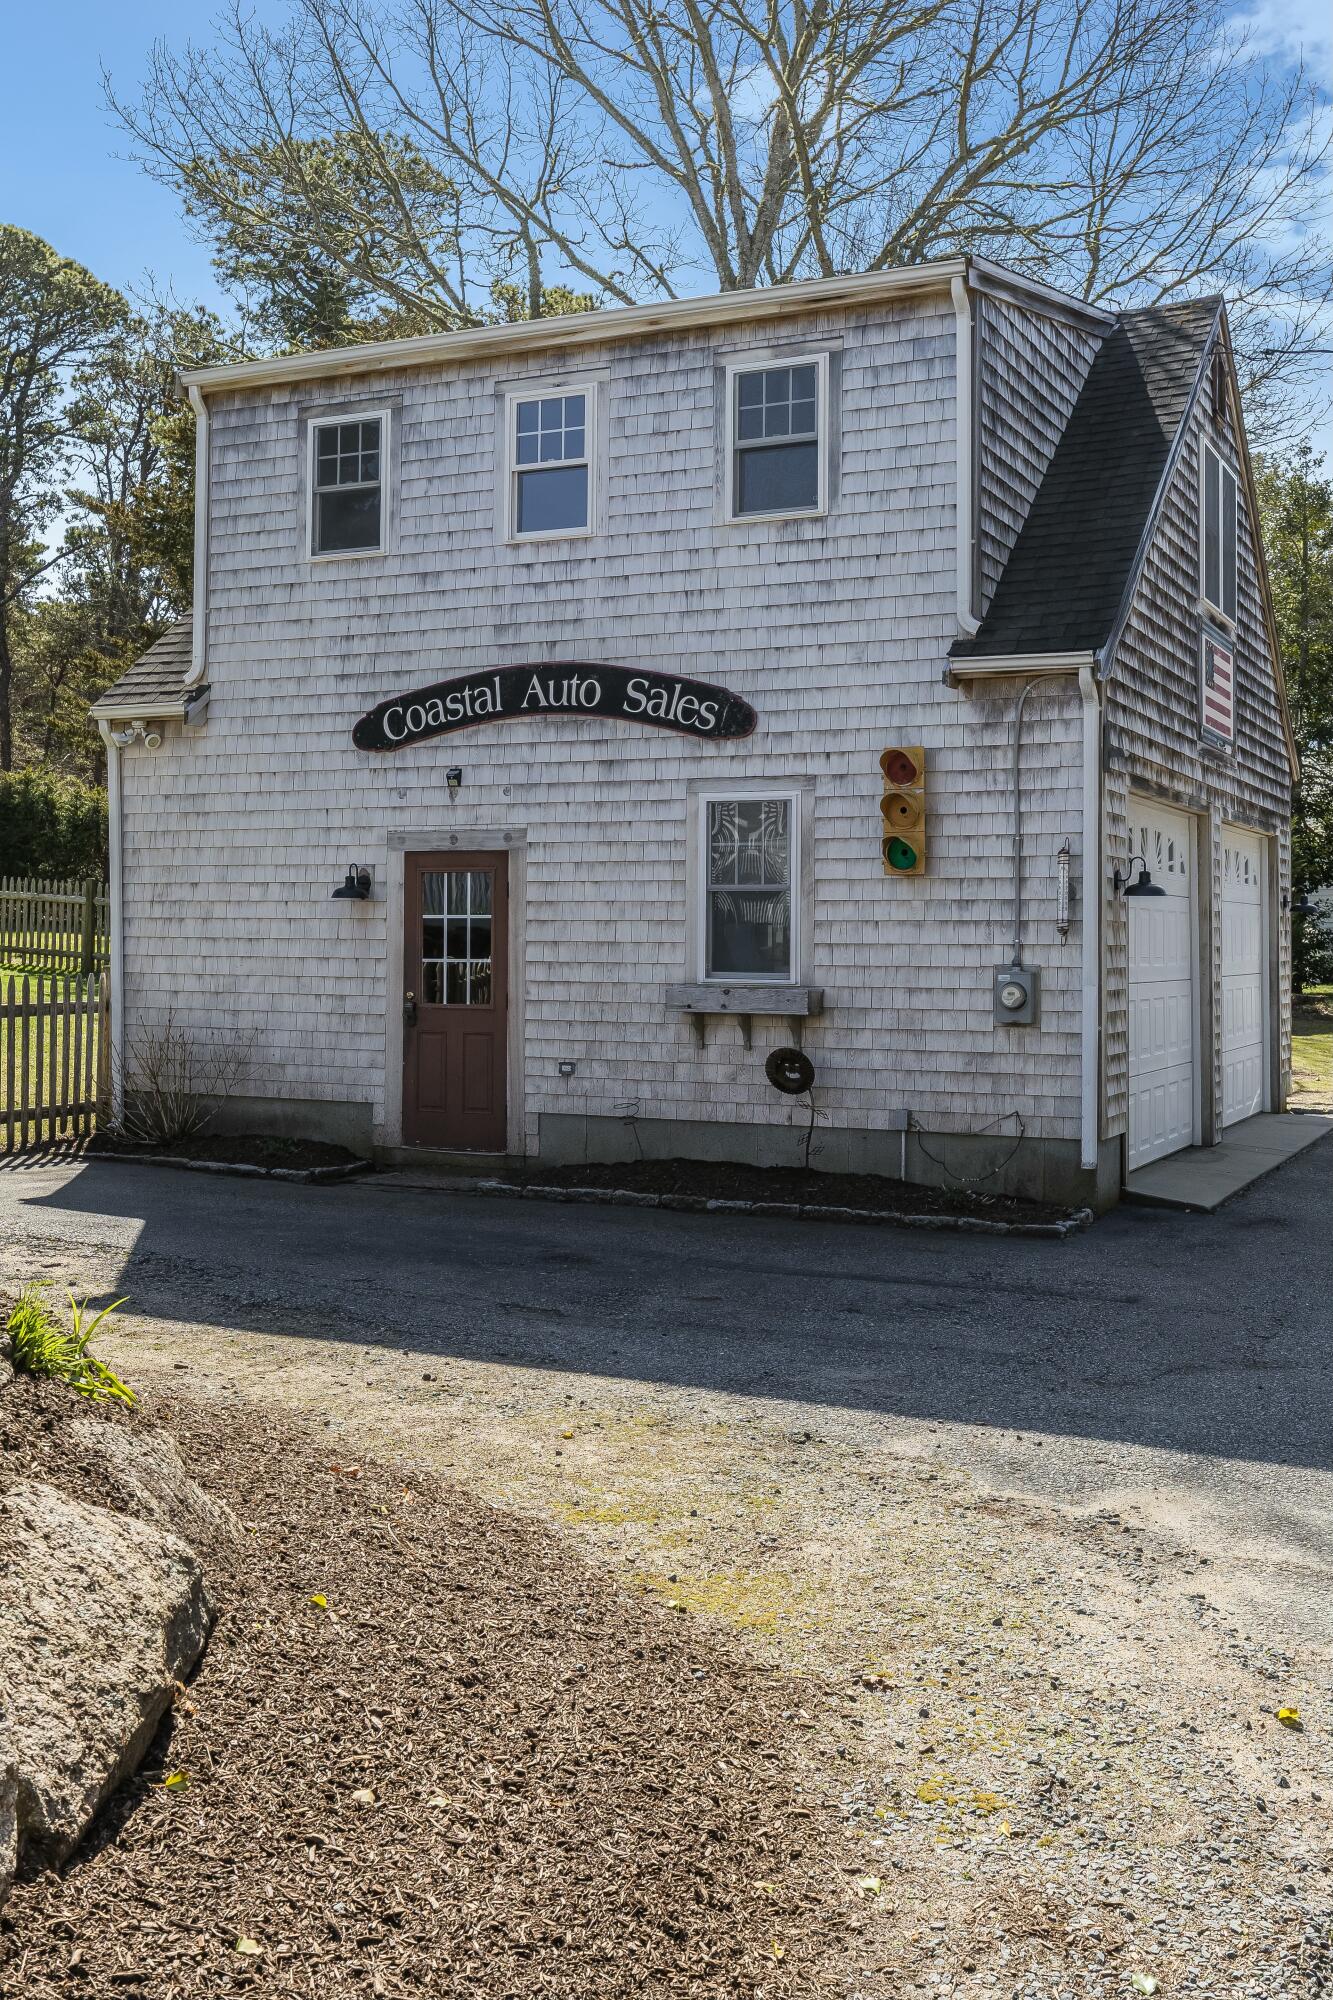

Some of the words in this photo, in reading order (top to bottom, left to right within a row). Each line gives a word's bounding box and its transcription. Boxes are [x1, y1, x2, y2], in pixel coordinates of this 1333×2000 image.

[382, 676, 503, 740] Coastal
[520, 673, 602, 708] Auto
[622, 678, 719, 730] Sales
